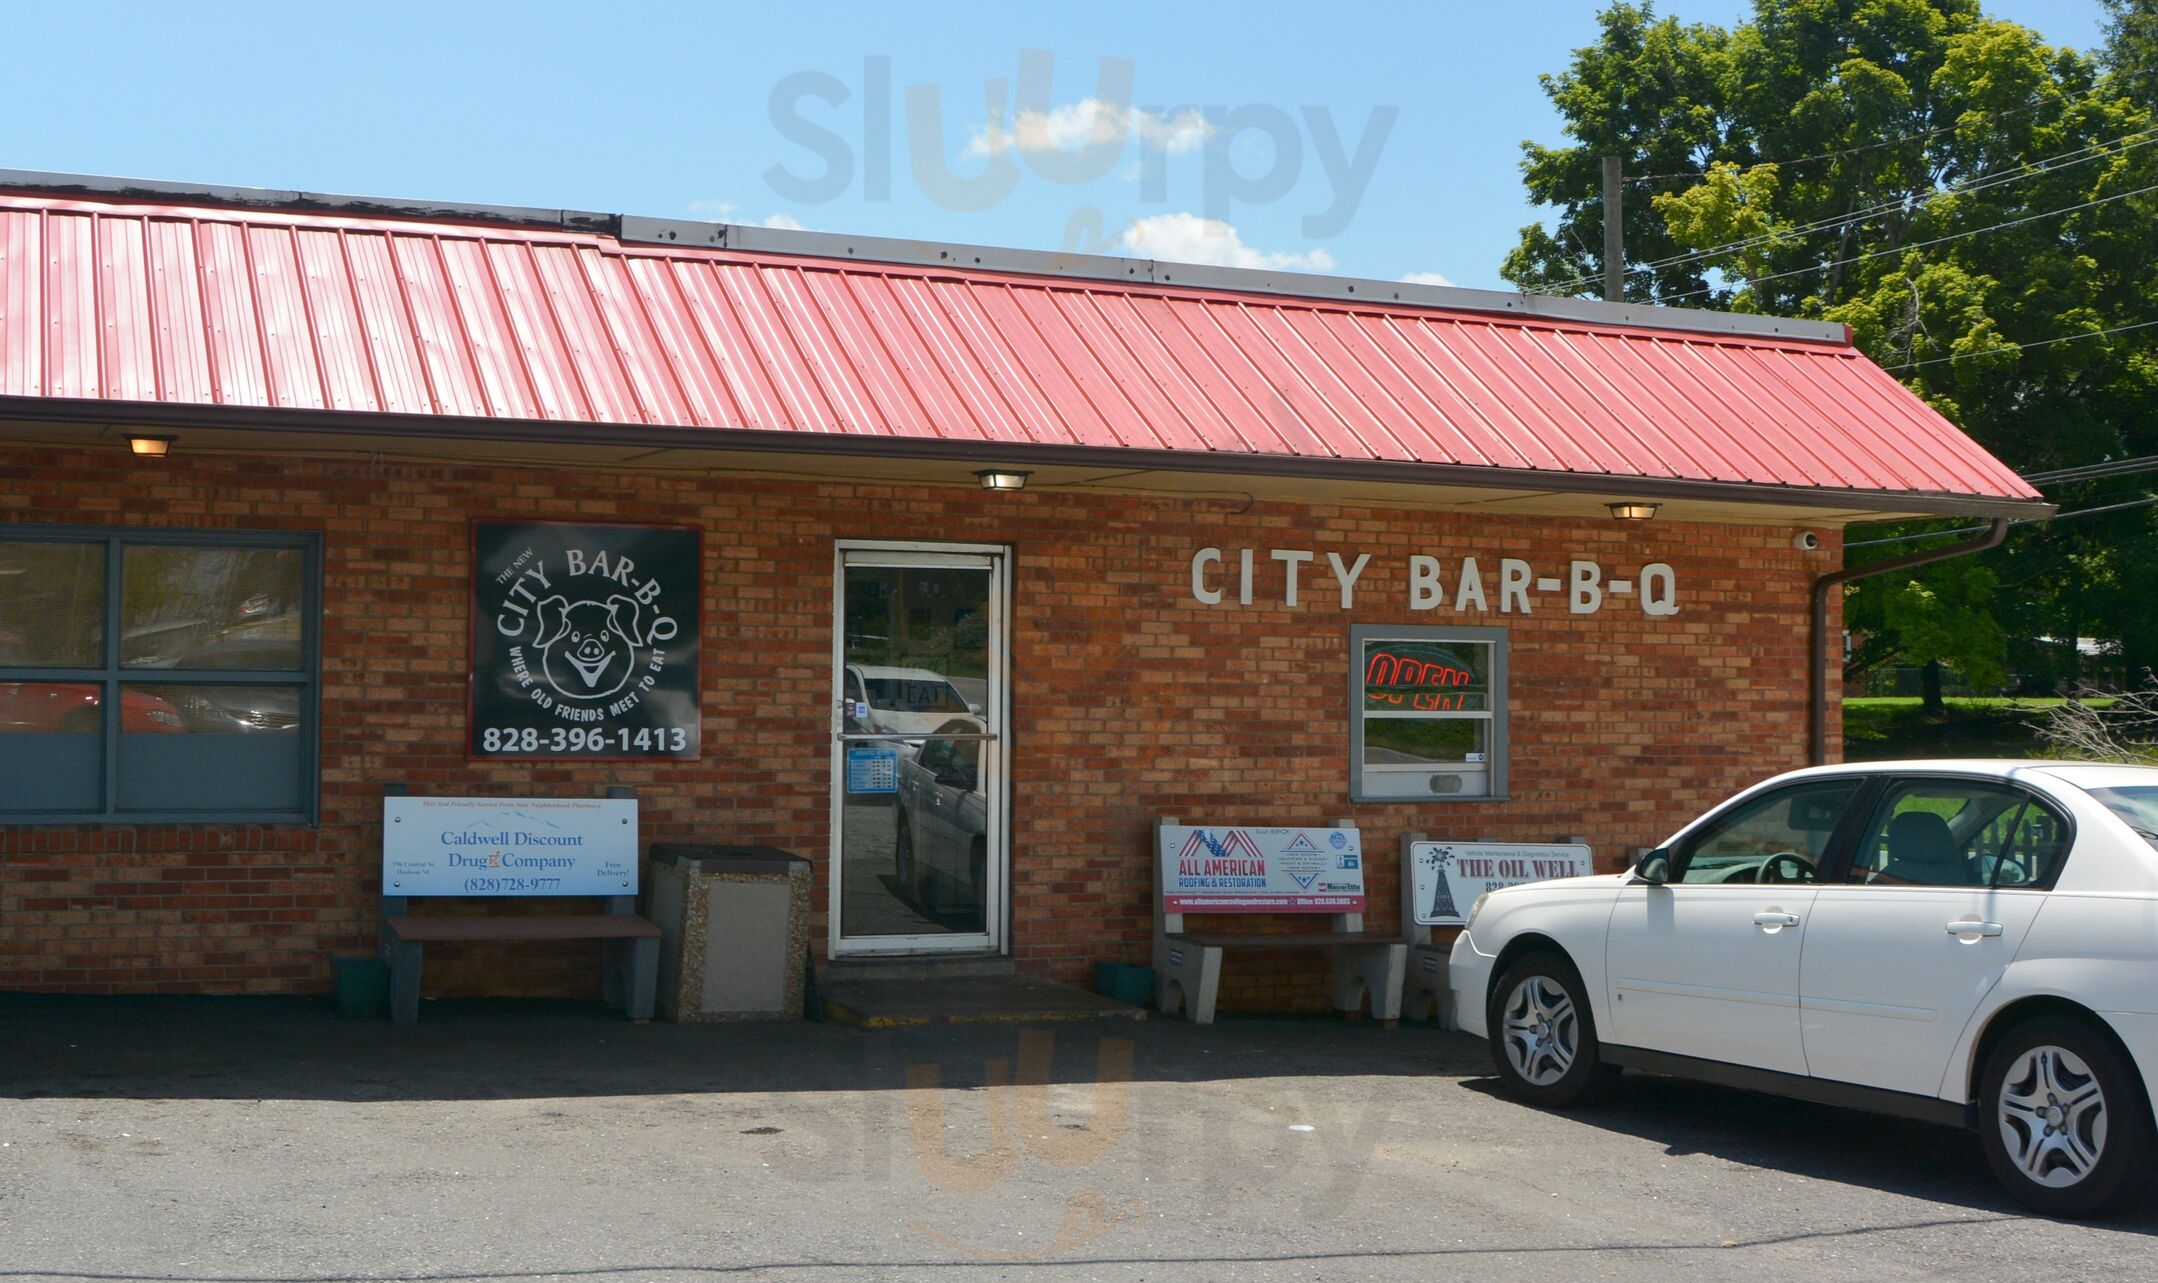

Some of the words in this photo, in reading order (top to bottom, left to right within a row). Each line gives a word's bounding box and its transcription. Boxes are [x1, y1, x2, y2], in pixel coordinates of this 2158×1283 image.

[496, 566, 514, 585] THE
[513, 546, 534, 568] NEW
[1191, 547, 1371, 609] CITY
[1409, 555, 1680, 616] BAR-B-Q
[497, 560, 551, 637] CITY
[565, 549, 678, 645] BAR-B-Q
[509, 646, 533, 688] WHERE
[531, 688, 551, 709] OLD
[555, 703, 604, 722] FRIENDS
[610, 692, 641, 717] MEET
[639, 676, 655, 692] TO
[649, 648, 666, 673] EAT
[482, 727, 687, 752] 828-396-1413
[441, 831, 509, 846] Caldwell
[514, 832, 583, 846] Discount
[448, 853, 487, 870] Drug
[501, 853, 576, 870] Company
[605, 861, 621, 869] Free
[1179, 859, 1202, 876] ALL
[1204, 859, 1266, 876] AMERICAN
[1456, 858, 1495, 877] THE
[1498, 859, 1529, 878] OIL
[1532, 860, 1579, 878] WELL
[1179, 878, 1211, 888] ROOFING
[1212, 878, 1218, 888] &
[1219, 878, 1267, 888] RESTORATION
